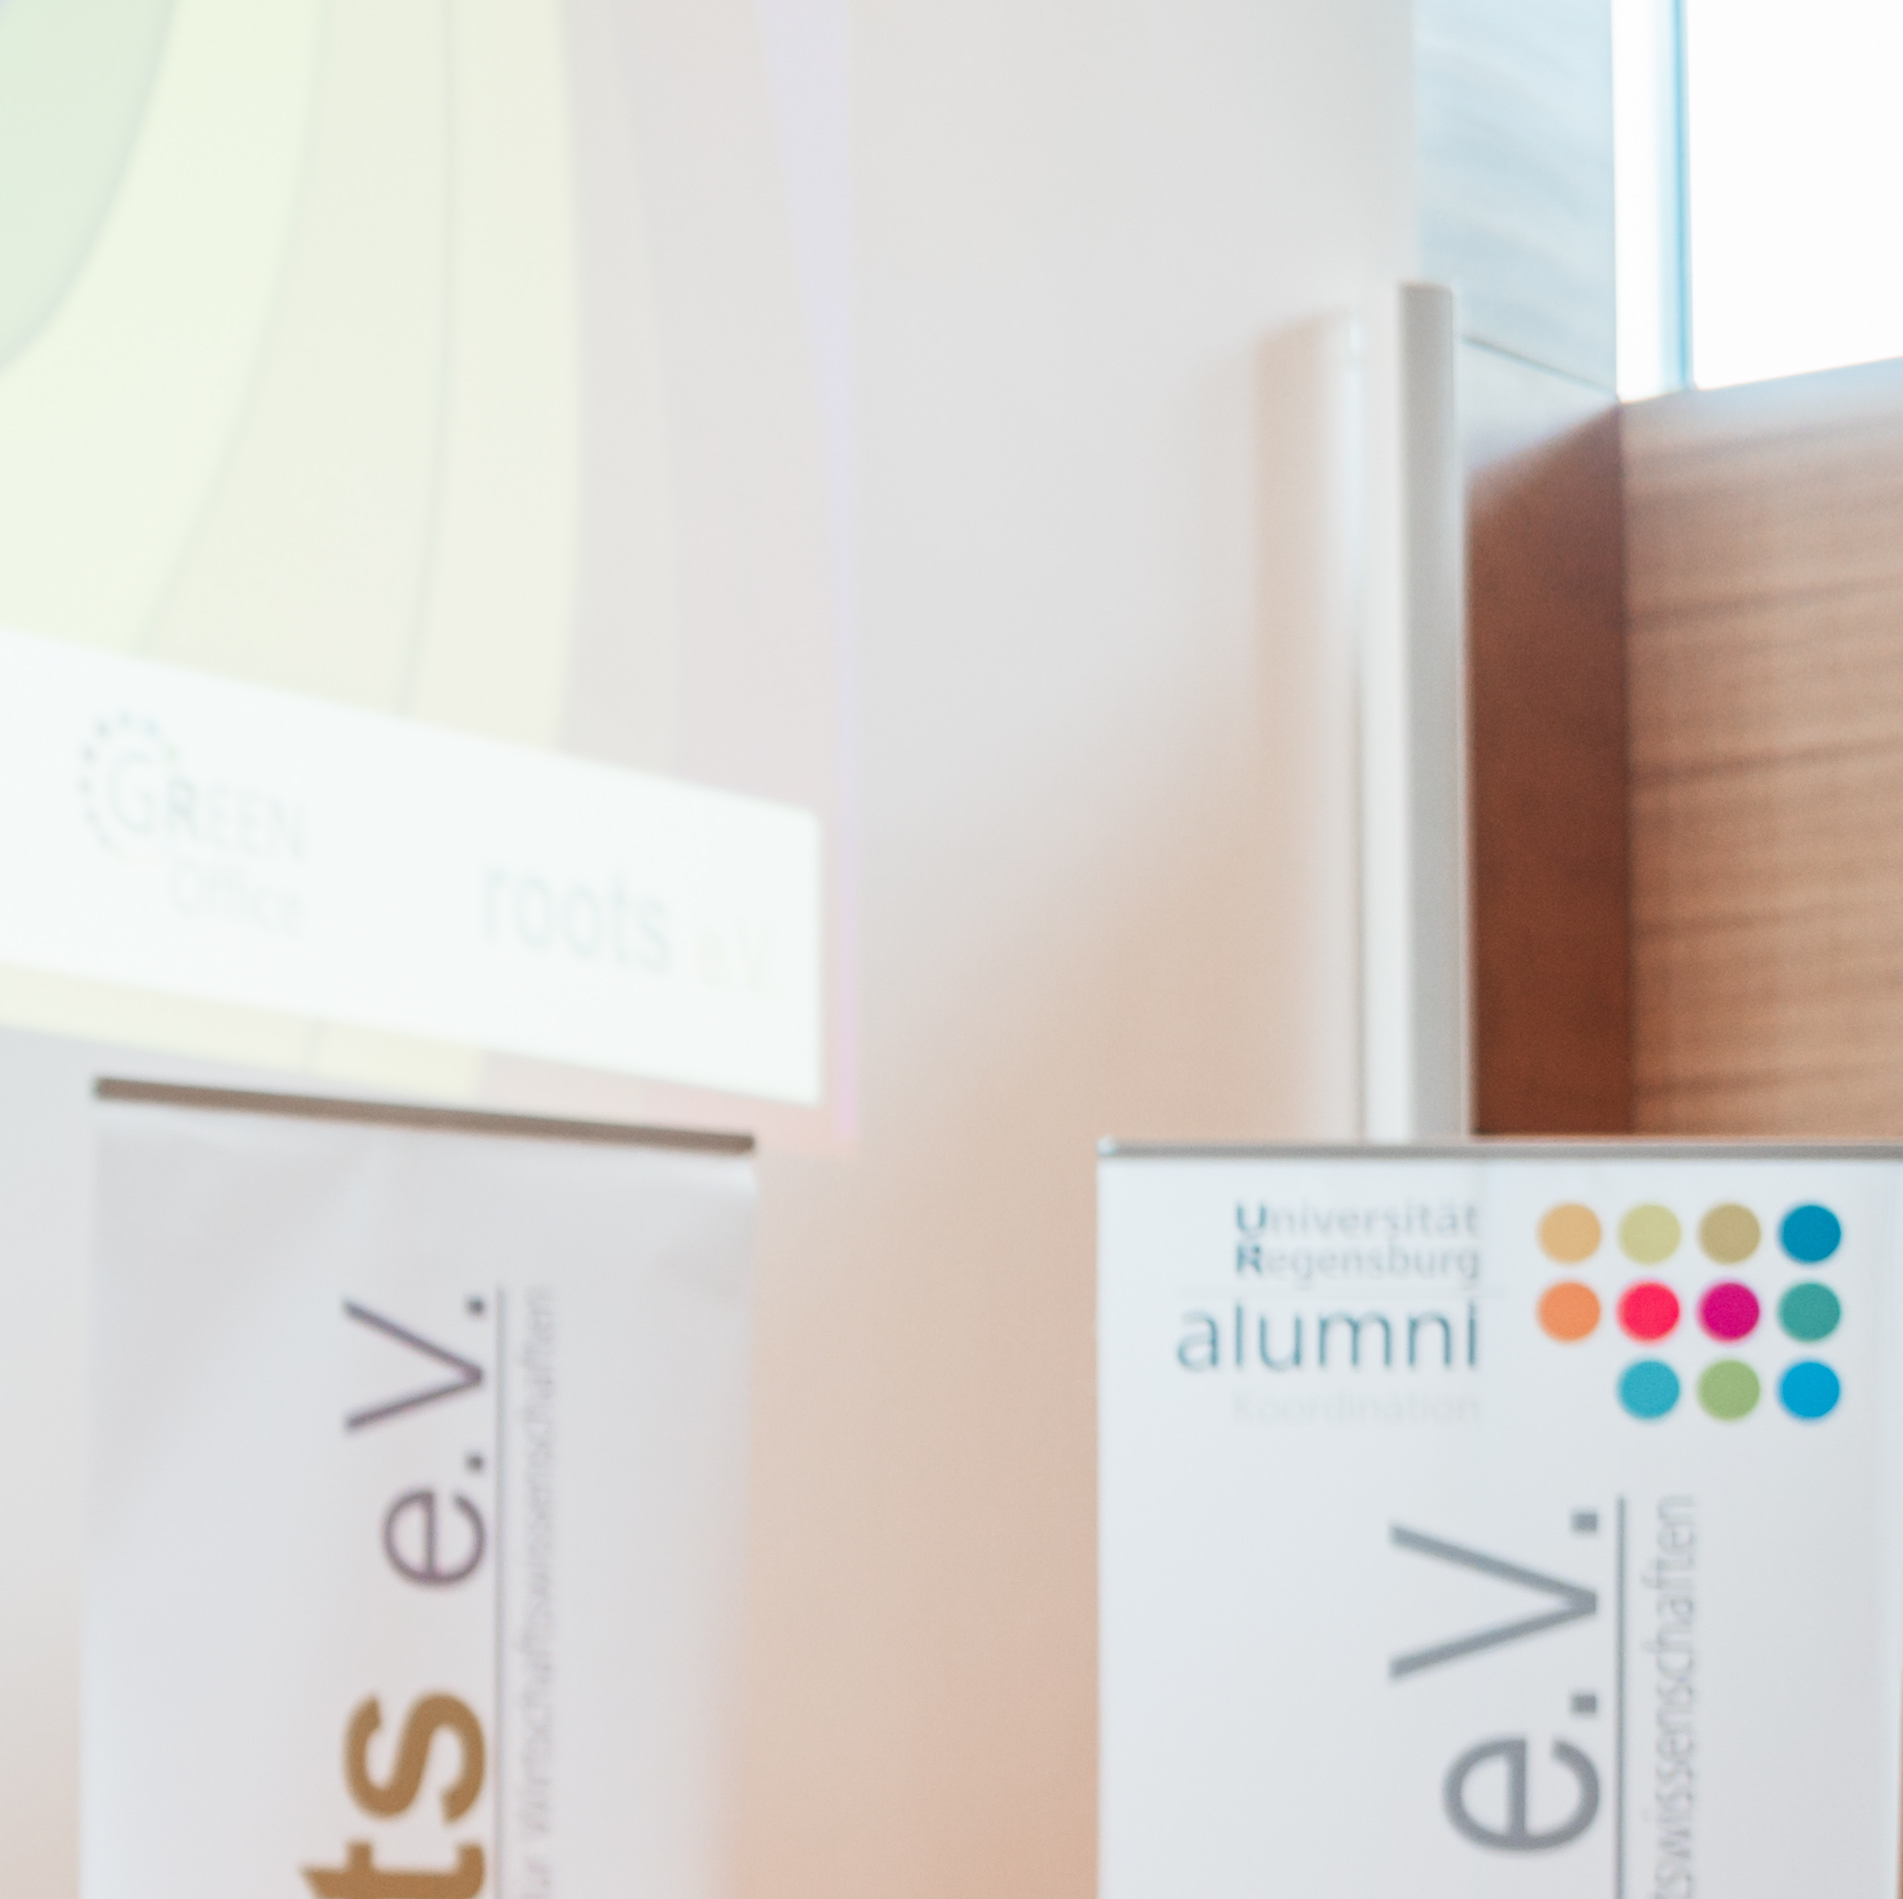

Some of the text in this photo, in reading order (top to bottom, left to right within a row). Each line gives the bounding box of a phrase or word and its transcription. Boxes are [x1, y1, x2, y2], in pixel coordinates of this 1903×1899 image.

[103, 747, 309, 862] GREEN
[479, 856, 675, 976] roots
[1234, 1197, 1481, 1238] Universität
[1234, 1238, 1482, 1292] Regensburg
[1176, 1296, 1481, 1374] alumni
[343, 1295, 487, 1589] e.V.
[1388, 1509, 1603, 1857] e.V.
